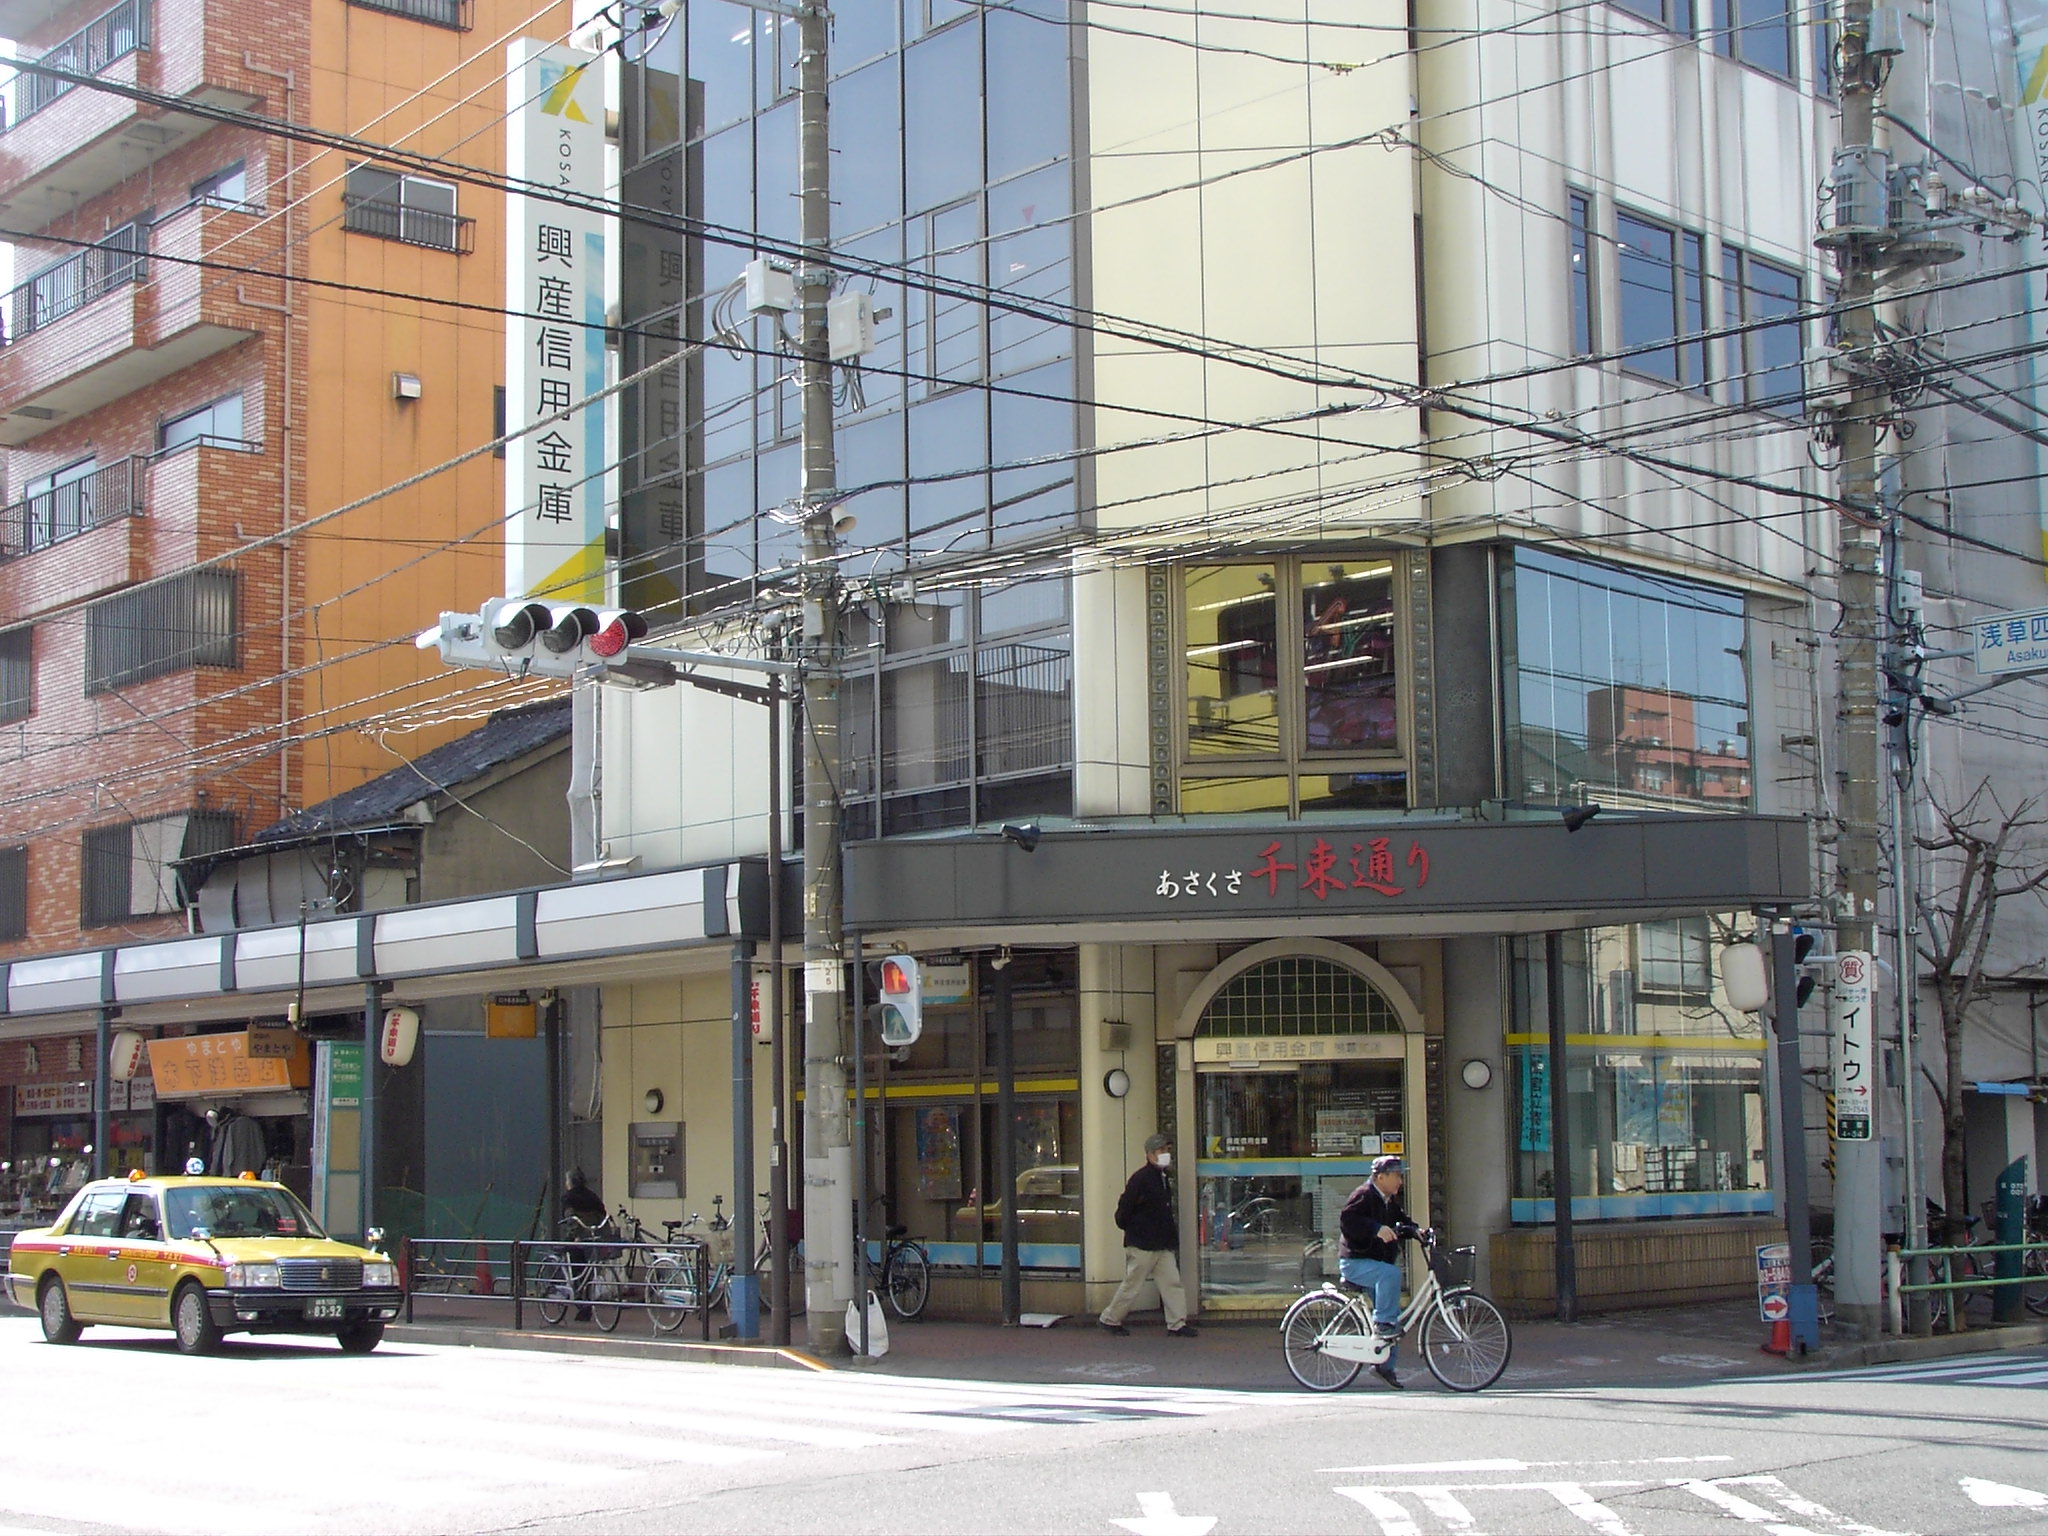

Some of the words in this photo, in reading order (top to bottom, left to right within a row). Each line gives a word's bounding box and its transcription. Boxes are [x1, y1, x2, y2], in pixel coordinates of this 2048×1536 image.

[559, 128, 572, 199] KOSA
[536, 224, 573, 524] 興産信用金庫
[1156, 869, 1242, 898] あさくさ
[1250, 837, 1431, 900] 千束通り
[1844, 961, 1858, 978] 質
[186, 1039, 242, 1056] やまとや
[1216, 1042, 1325, 1058] 興産信用金庫
[1842, 1007, 1861, 1081] イトウ
[163, 1252, 183, 1261] TAXI
